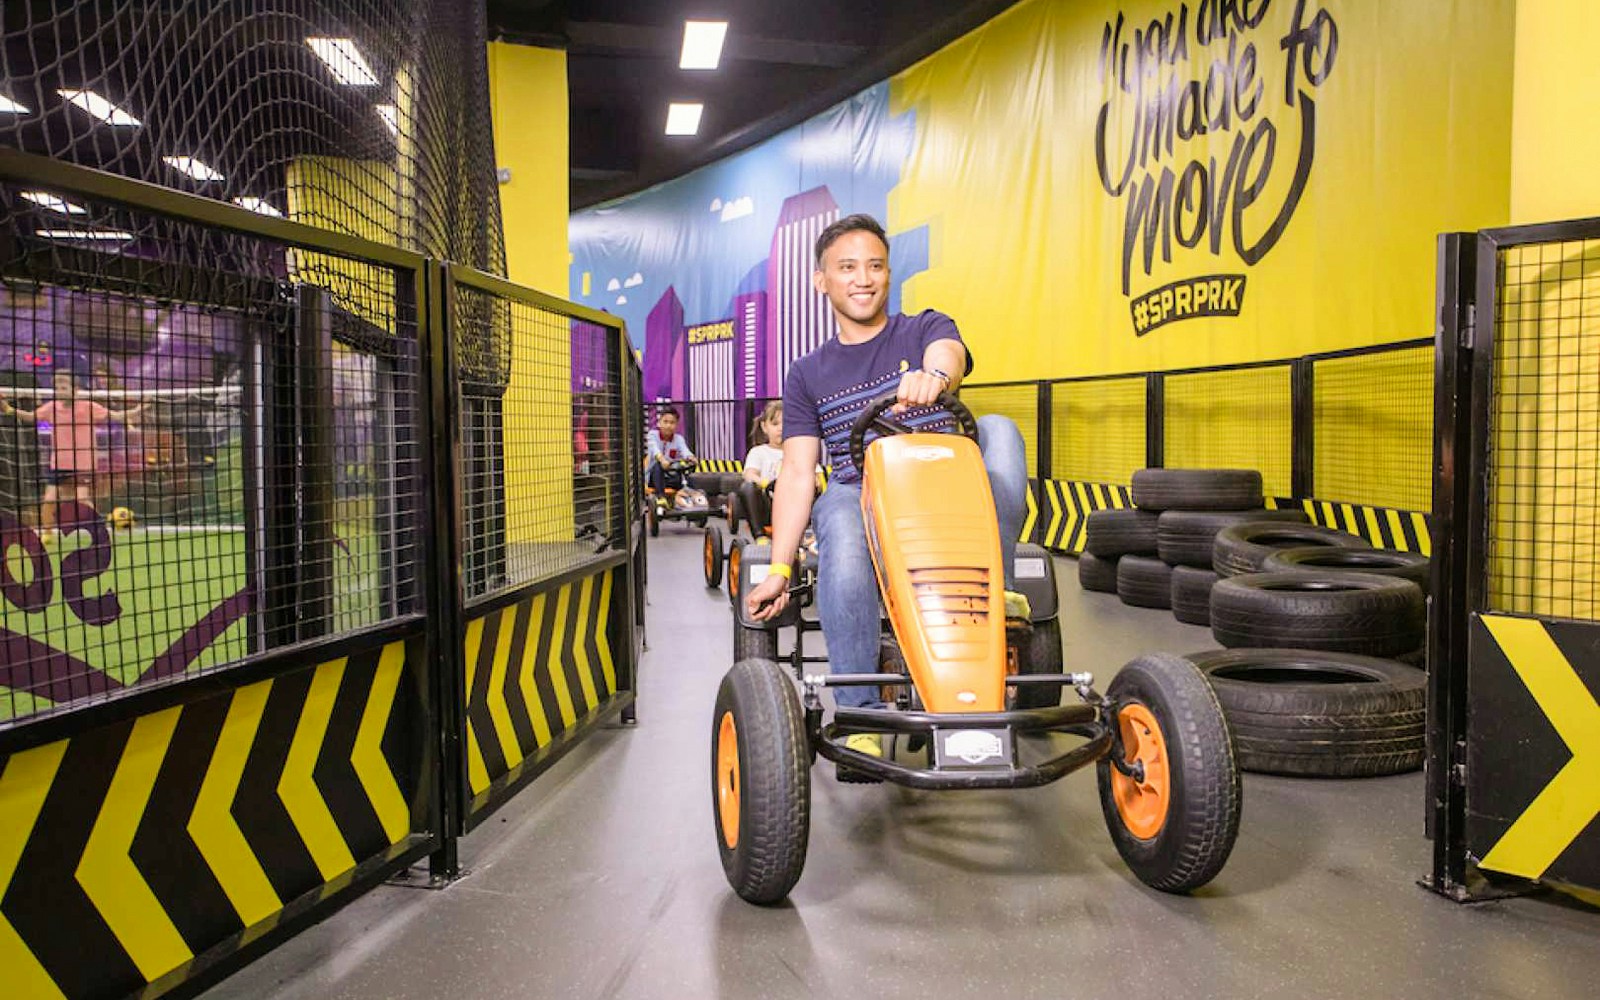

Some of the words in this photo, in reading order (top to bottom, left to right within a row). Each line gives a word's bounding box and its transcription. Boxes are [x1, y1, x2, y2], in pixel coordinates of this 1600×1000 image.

[1280, 0, 1338, 107] to
[1122, 88, 1315, 296] move
[1133, 278, 1242, 332] #SPRPRK
